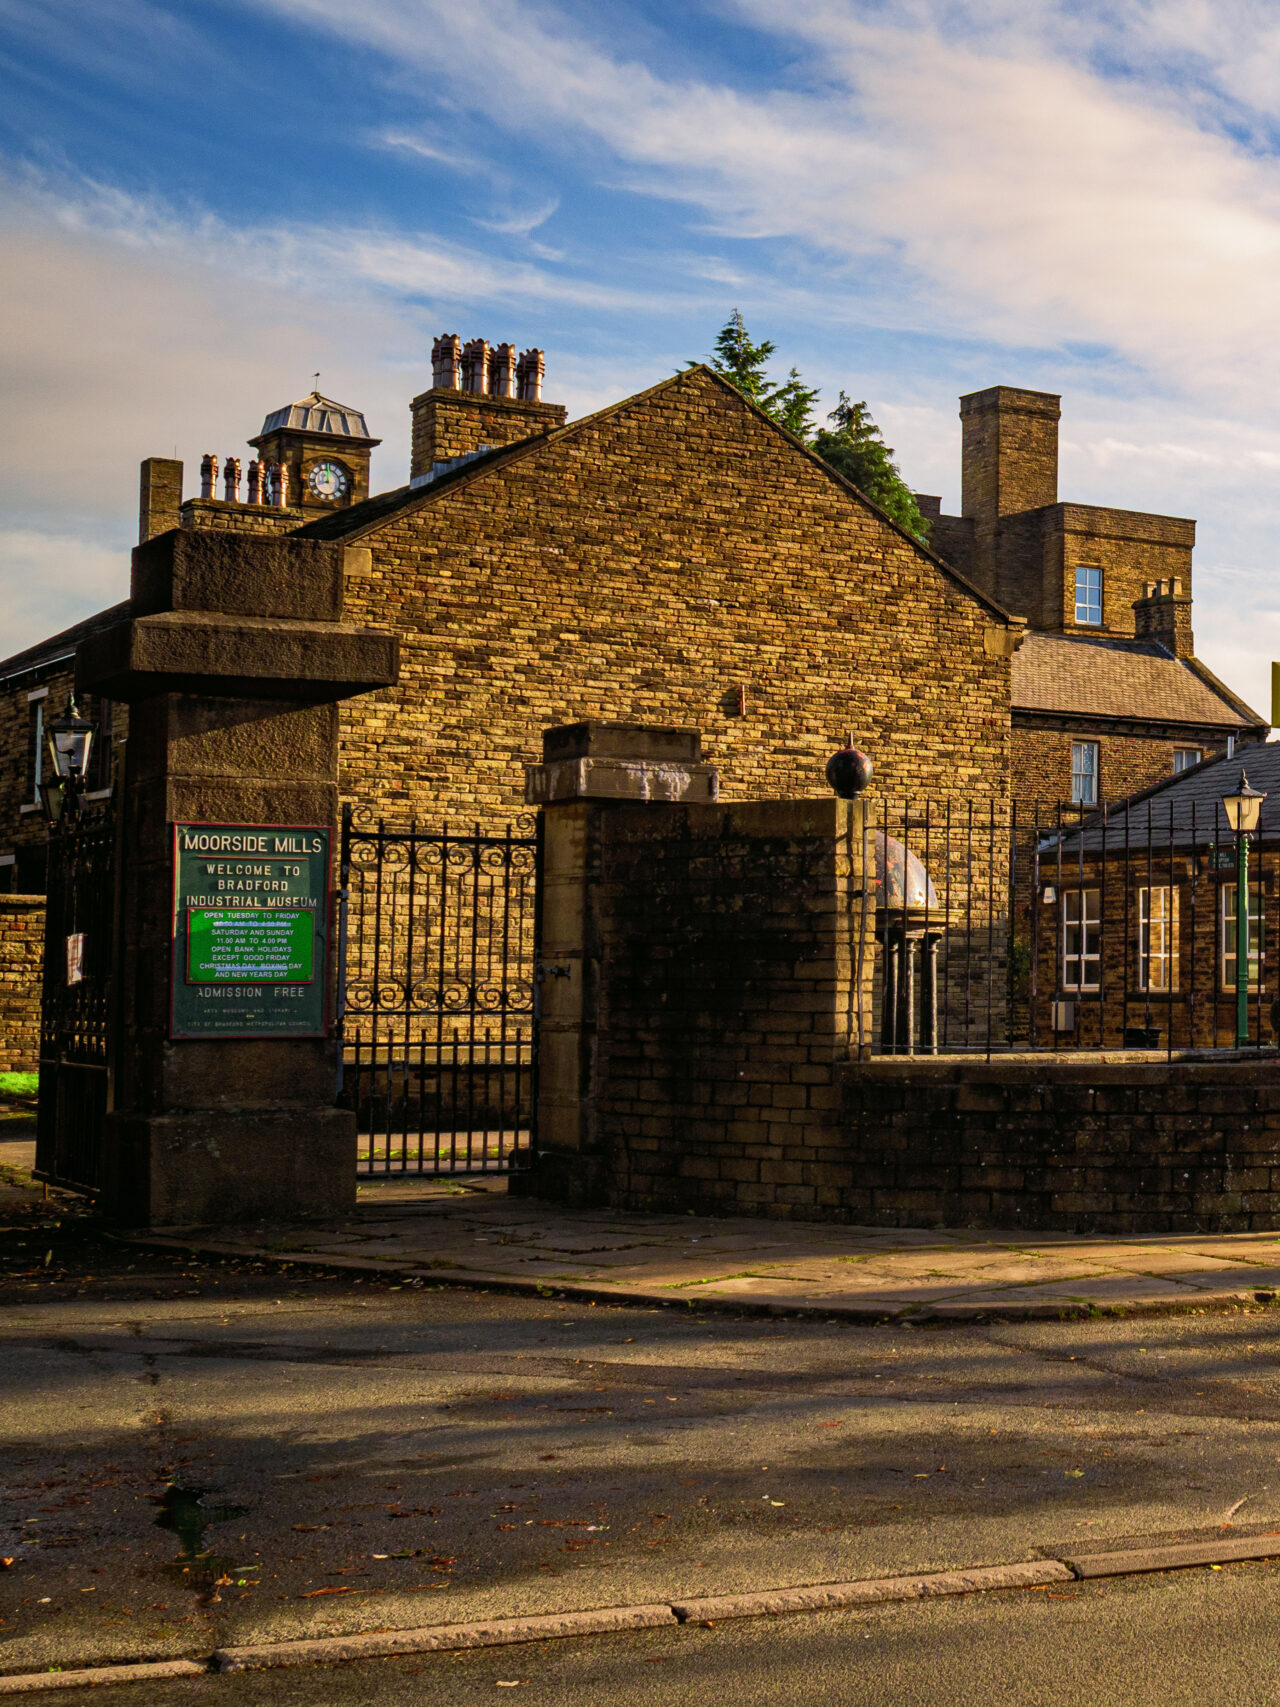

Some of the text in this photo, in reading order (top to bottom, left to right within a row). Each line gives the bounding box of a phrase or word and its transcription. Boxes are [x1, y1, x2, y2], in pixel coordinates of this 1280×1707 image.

[184, 834, 322, 853] MOORSIDE MILLS
[206, 864, 300, 876] WELCOME TO
[217, 879, 289, 891] BRADFORD
[186, 895, 317, 907] INDUSTRIAL MUSEUM
[196, 987, 305, 998] ADMISSION FREE
